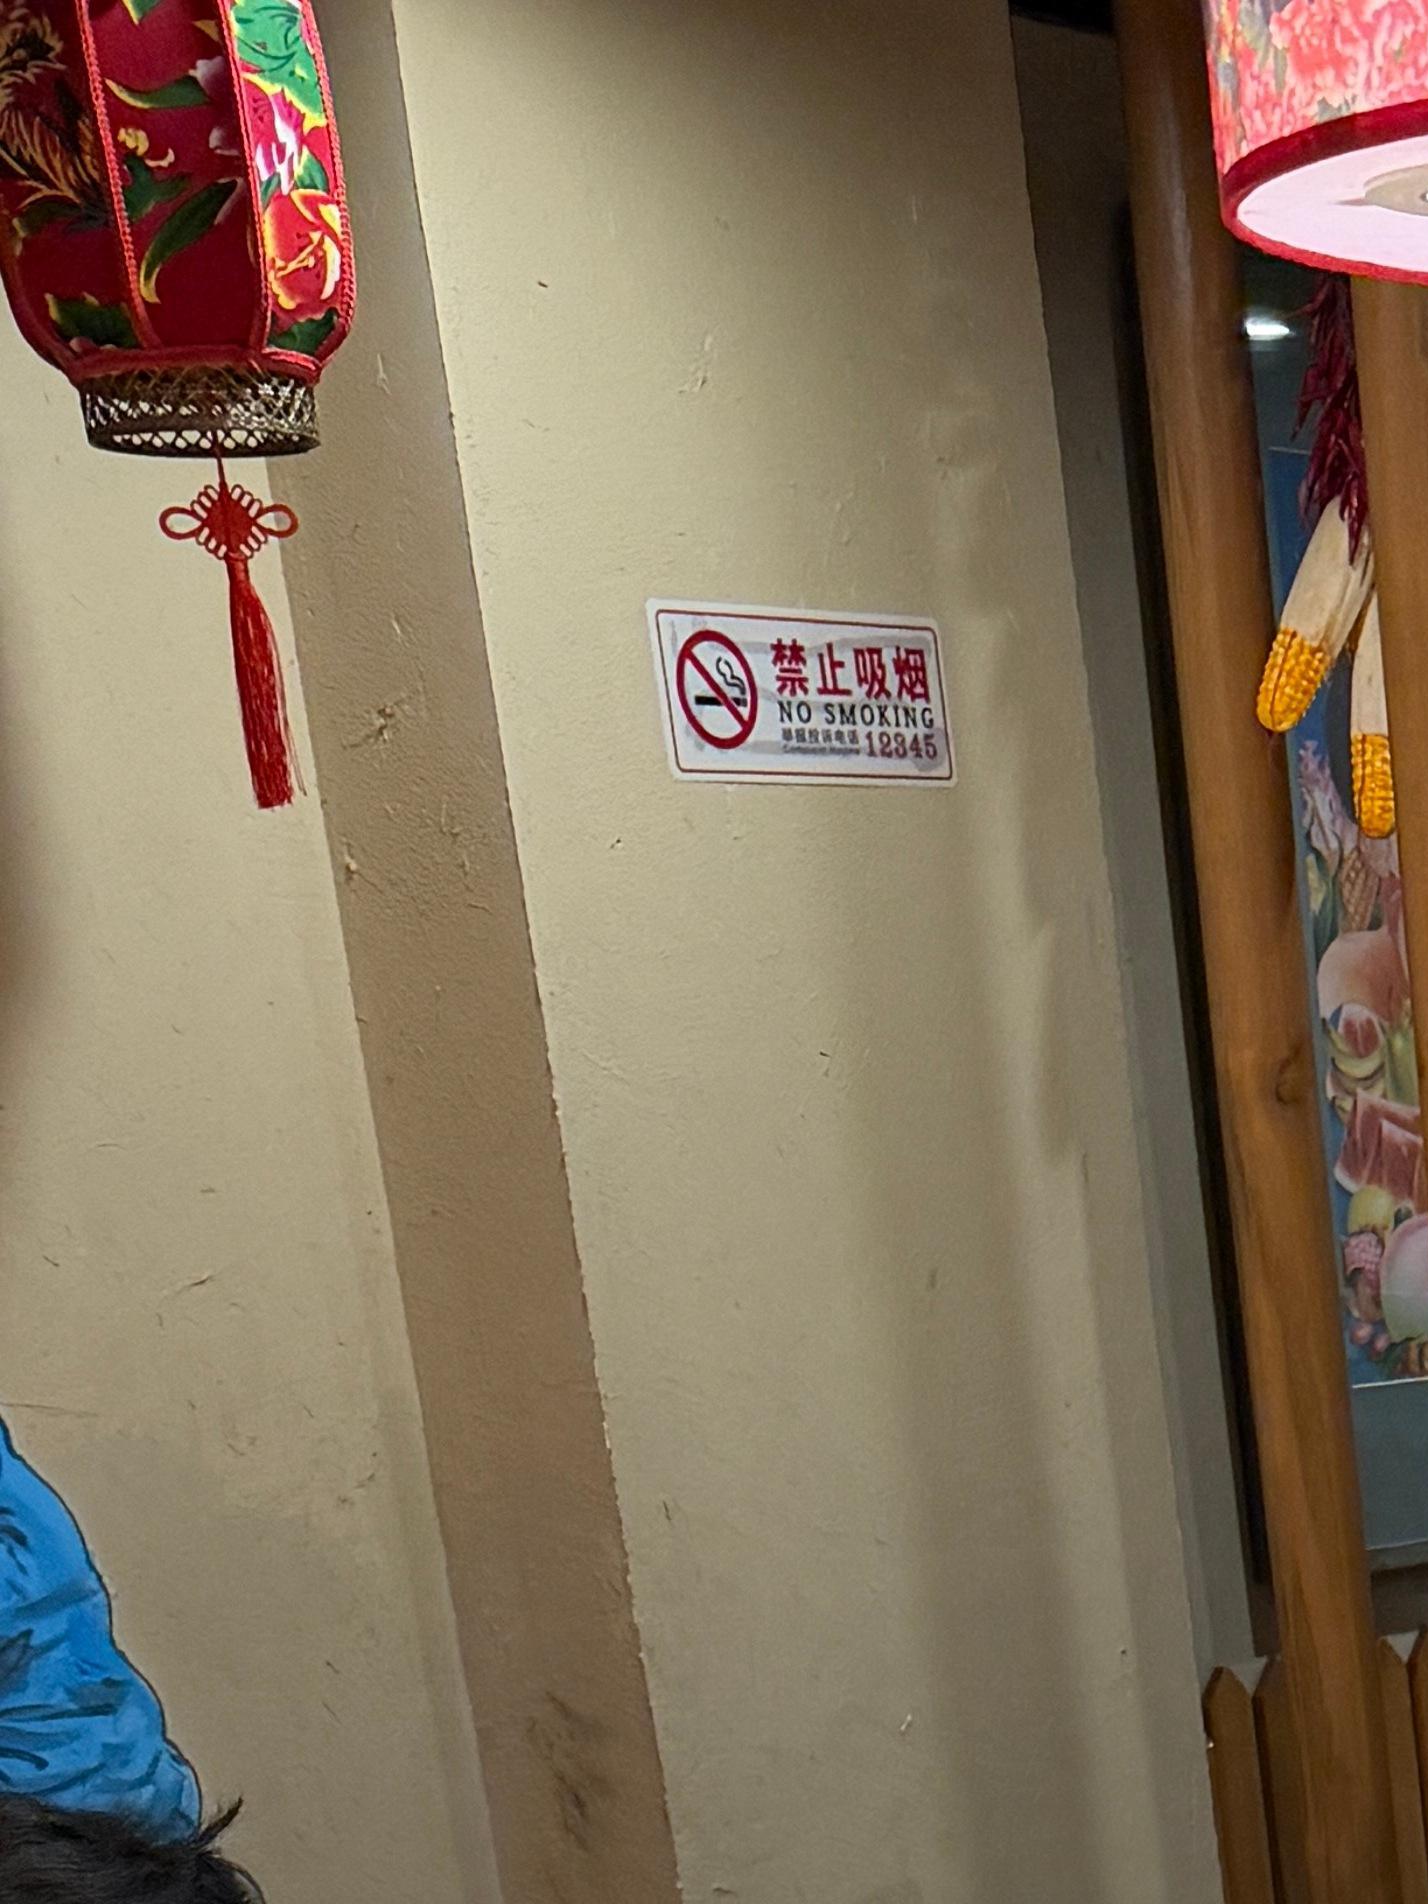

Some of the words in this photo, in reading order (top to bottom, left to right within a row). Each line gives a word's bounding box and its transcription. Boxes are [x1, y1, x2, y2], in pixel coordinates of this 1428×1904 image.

[770, 638, 931, 704] 禁止吸烟
[778, 700, 812, 724] NO
[825, 703, 934, 729] SMOKING
[865, 731, 938, 760] 12345
